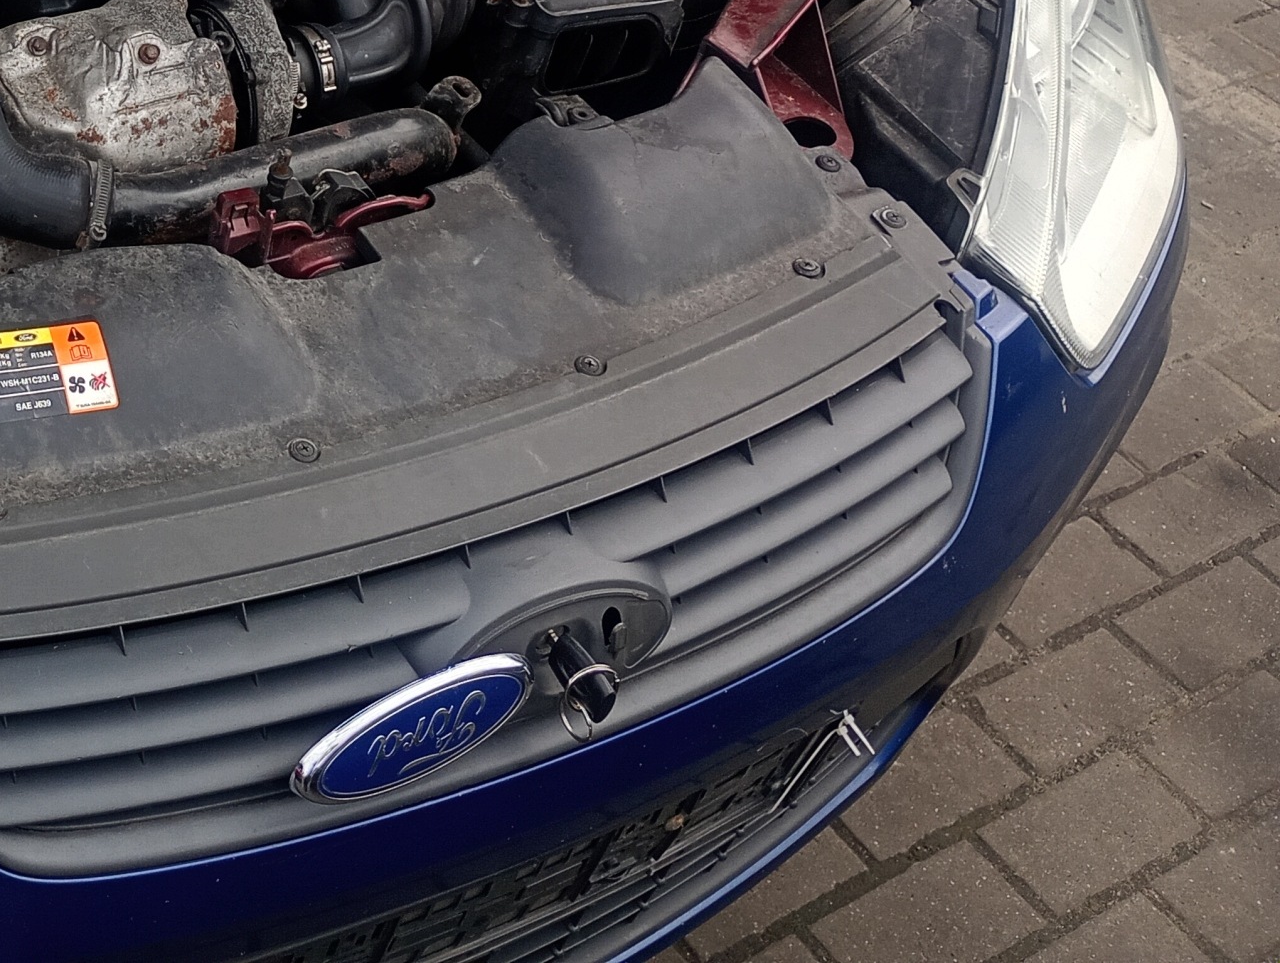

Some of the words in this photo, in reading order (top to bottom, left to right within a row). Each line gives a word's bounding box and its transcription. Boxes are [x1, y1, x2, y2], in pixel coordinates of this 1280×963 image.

[30, 351, 53, 359] R134A
[15, 401, 33, 411] SAE
[33, 399, 52, 409] J639
[367, 689, 487, 778] Ford
